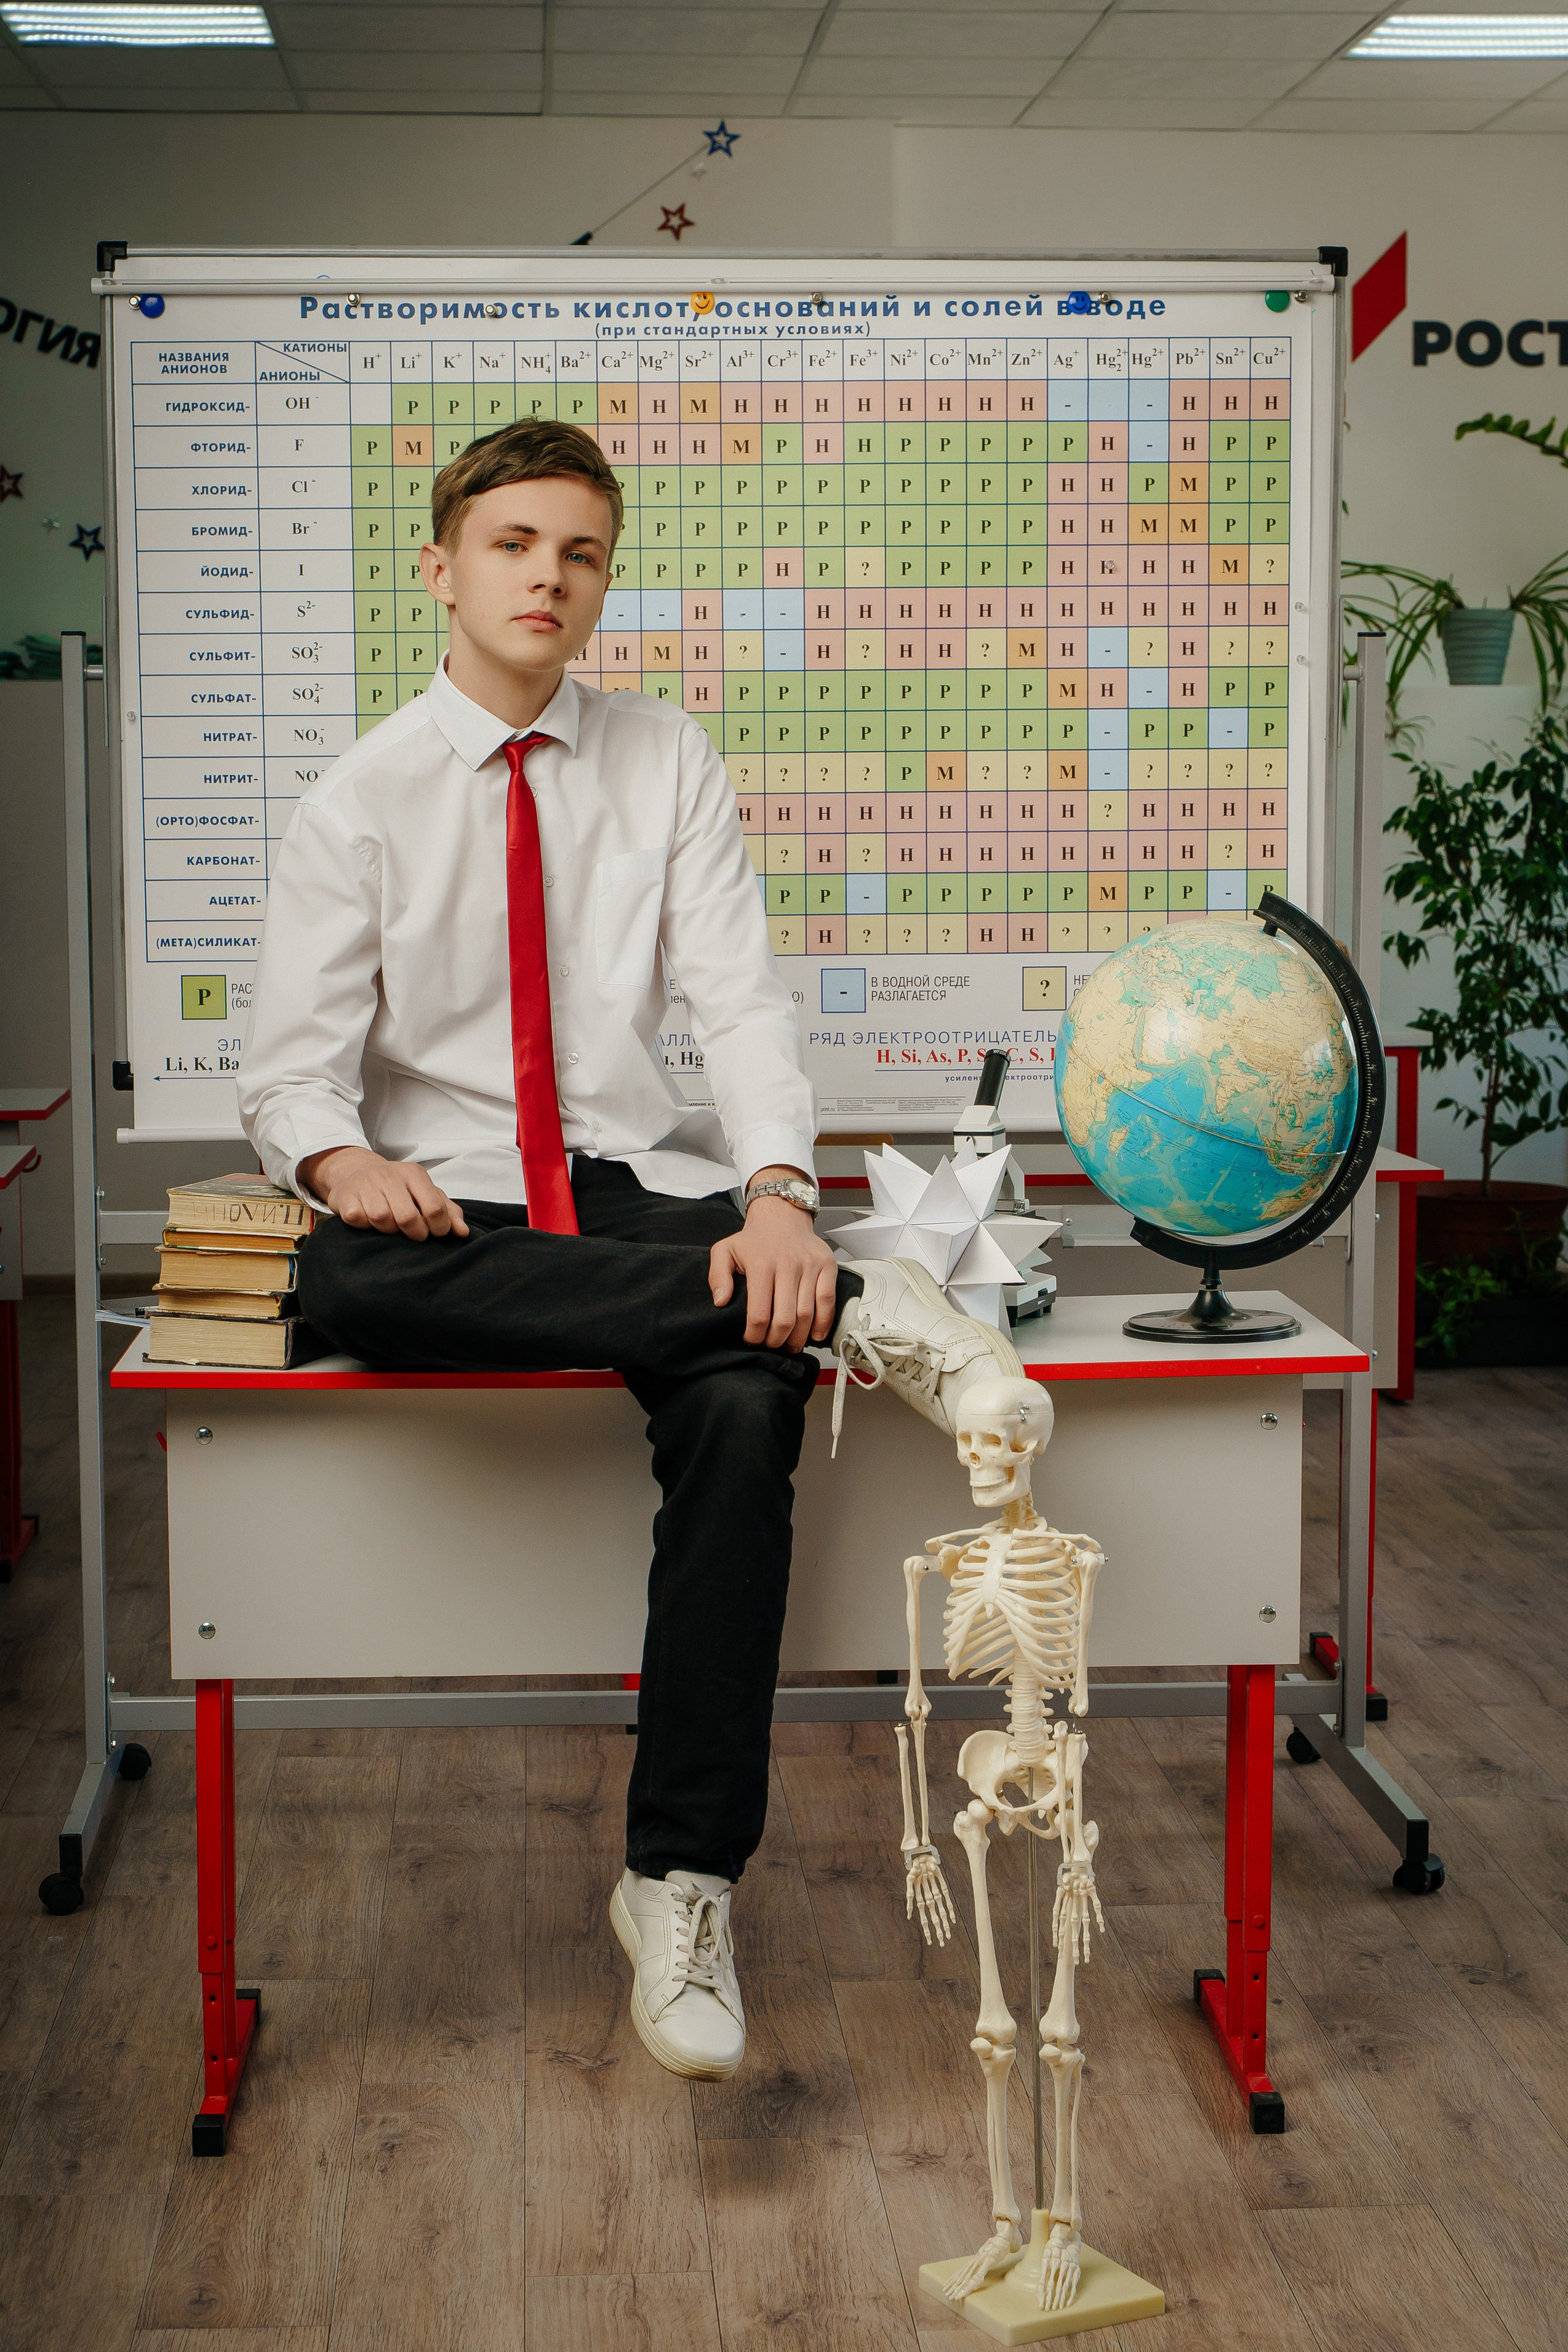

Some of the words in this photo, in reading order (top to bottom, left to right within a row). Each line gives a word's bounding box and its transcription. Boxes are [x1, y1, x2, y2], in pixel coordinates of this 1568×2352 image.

[299, 296, 560, 325] Растворимость
[714, 294, 900, 318] оснований
[914, 301, 931, 317] и
[944, 294, 1043, 317] солей
[1087, 299, 1166, 320] воде
[595, 322, 636, 339] (при
[643, 320, 768, 339] стандартных
[775, 321, 873, 339] условиях)
[283, 343, 347, 353] КАТИОНЫ
[159, 352, 229, 363] НАЗВАНИЯ
[160, 364, 228, 374] АНИОНОВ
[258, 371, 320, 382] АНИОНЫ
[165, 402, 251, 413] ГИДРОКСИД-
[190, 442, 251, 454] ФТОРИД-
[191, 485, 252, 497] ХЛОРИД-
[192, 526, 253, 537] БРОМИД-
[201, 565, 254, 578] ЙОДИД-
[186, 609, 255, 620] СУЛЬФИД-
[189, 651, 256, 662] СУЛЬФИТ-
[190, 693, 257, 704] СУЛЬФАТ-
[203, 732, 258, 742] НИТРАТ-
[203, 774, 258, 784] НИТРИТ-
[156, 815, 260, 828] (ОРТО)ФОСФАТ-
[187, 856, 260, 866] КАРБОНАТ-
[209, 895, 262, 907] АЦЕТАТ-
[156, 937, 261, 950] (МЕТА)СИЛИКАТ-
[871, 976, 878, 987] В
[883, 974, 930, 989] ВОДНОЙ
[933, 976, 970, 989] СРЕДЕ
[197, 989, 211, 1006] Р
[871, 990, 946, 1001] РАЗЛАГАЕТСЯ
[810, 1032, 846, 1047] РЯД
[876, 1049, 896, 1066] H,
[901, 1049, 922, 1066] Si,
[925, 1049, 952, 1066] As,
[957, 1048, 971, 1066] P,
[193, 1057, 213, 1075] K,
